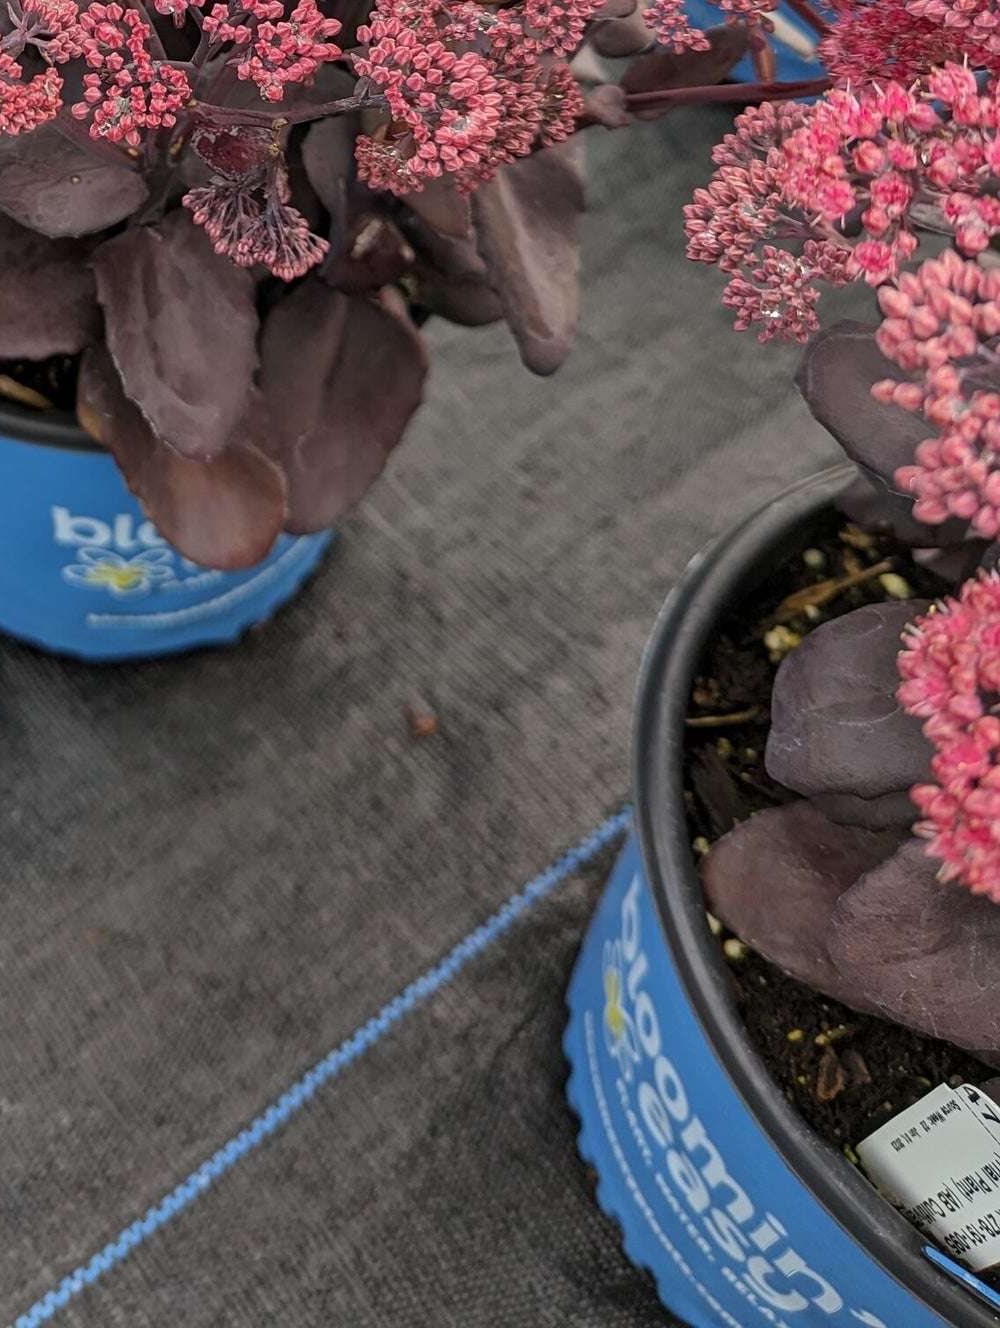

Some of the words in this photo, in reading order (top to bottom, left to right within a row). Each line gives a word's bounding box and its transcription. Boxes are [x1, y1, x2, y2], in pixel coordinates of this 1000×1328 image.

[638, 1082, 810, 1311] easy
[937, 1182, 964, 1213] (AB
[950, 1171, 992, 1204] Plant)
